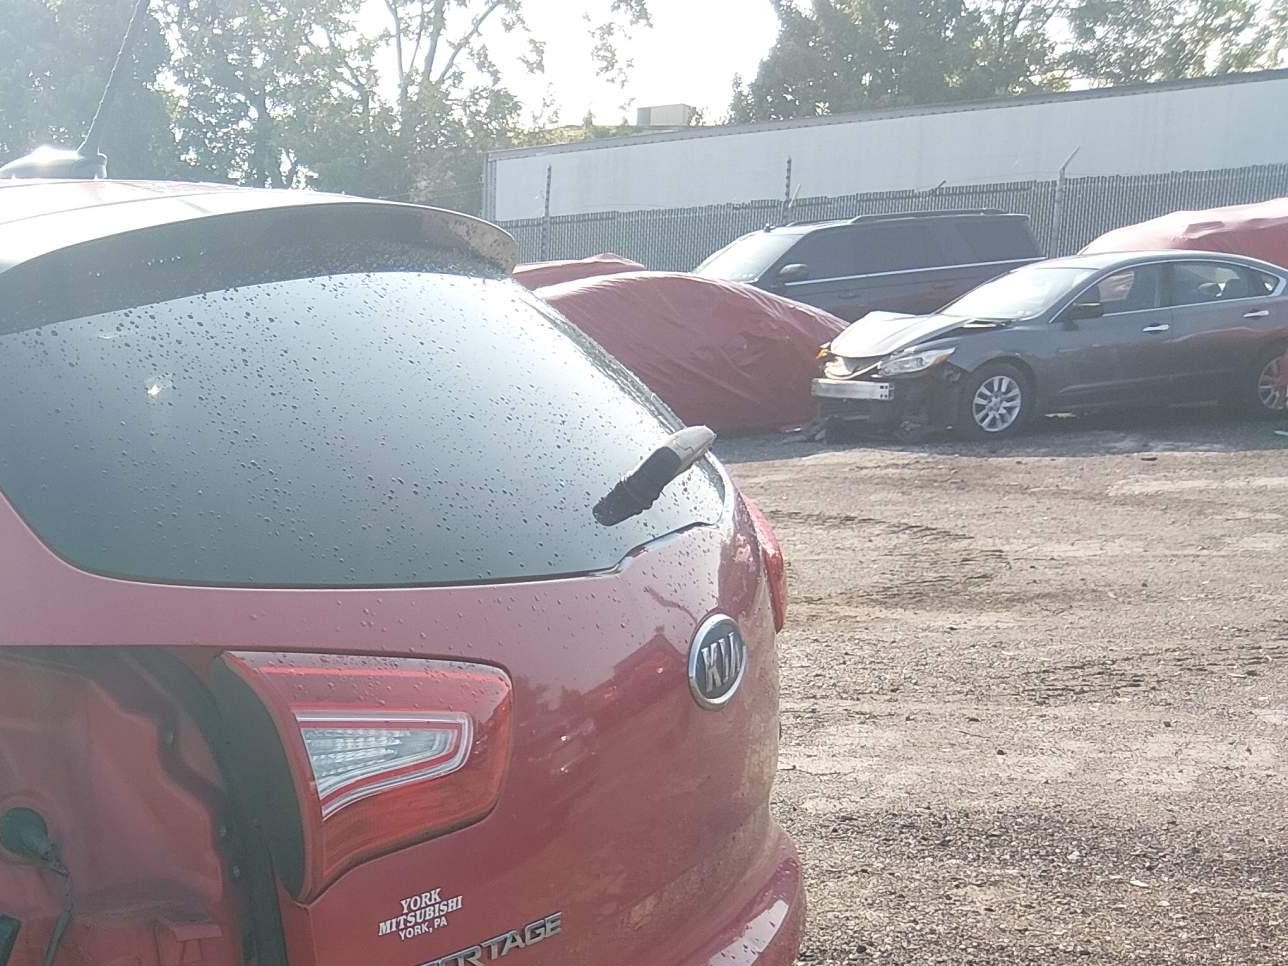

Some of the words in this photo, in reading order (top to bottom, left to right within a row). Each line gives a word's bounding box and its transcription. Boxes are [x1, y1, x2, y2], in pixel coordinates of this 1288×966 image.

[701, 631, 740, 692] KIA
[378, 895, 463, 936] MITSUBISHI
[400, 887, 441, 914] YORK
[398, 922, 433, 941] YORK,
[434, 916, 448, 930] PA
